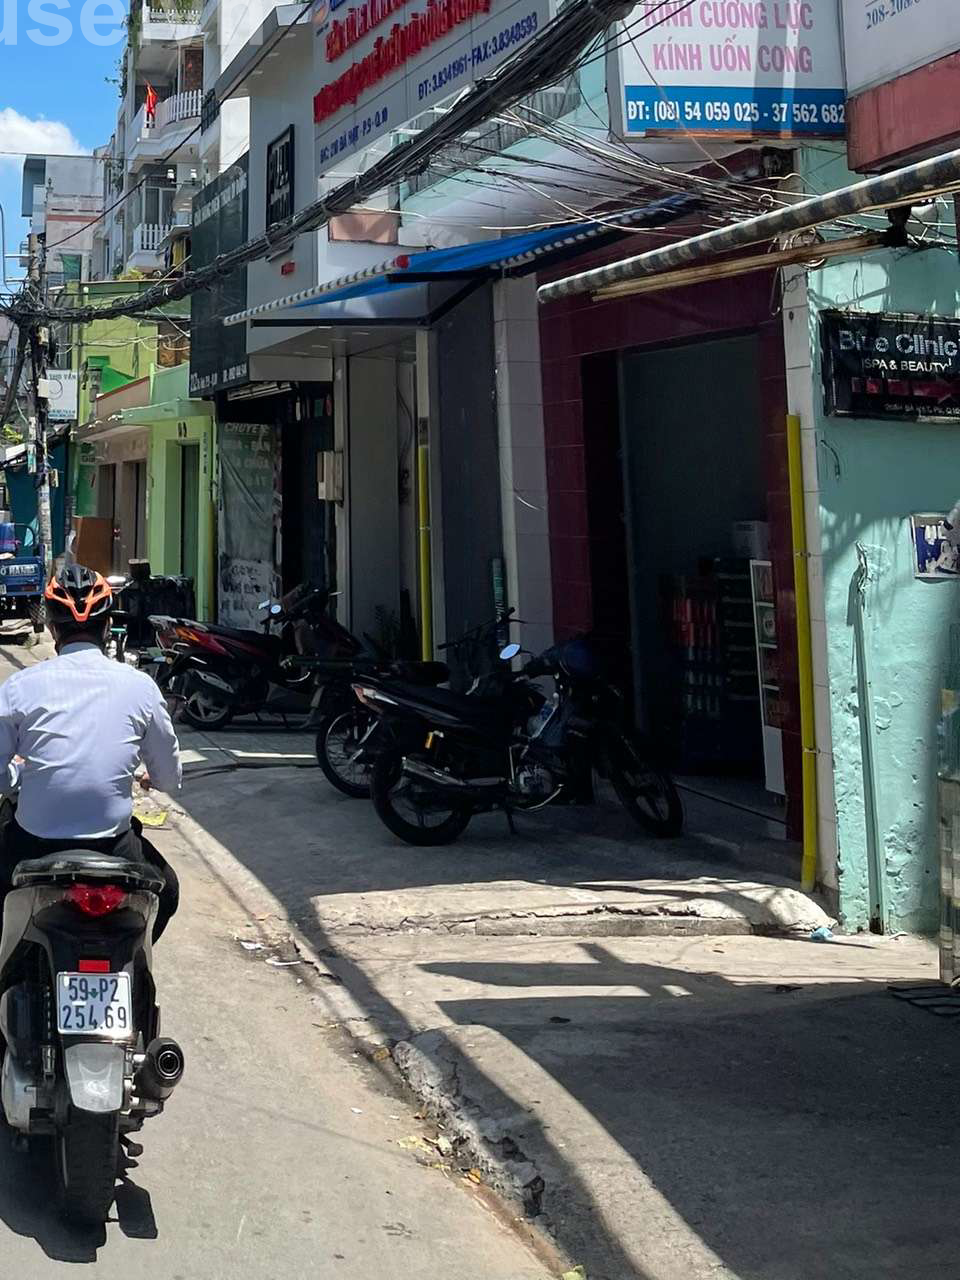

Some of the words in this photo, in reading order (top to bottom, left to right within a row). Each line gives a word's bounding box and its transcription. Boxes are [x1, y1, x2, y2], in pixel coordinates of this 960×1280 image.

[774, 0, 813, 35] LỰC
[653, 37, 702, 70] KÍNH
[710, 34, 751, 71] UỐN
[759, 45, 813, 73] CONG
[628, 101, 650, 120] ĐT:
[654, 100, 680, 122] (08)
[685, 102, 702, 120] 54
[705, 102, 730, 120] 059
[734, 103, 759, 121] 025
[773, 104, 788, 122] 37
[793, 104, 818, 123] 562
[821, 105, 845, 123] 682
[62, 1005, 127, 1029] 254.69
